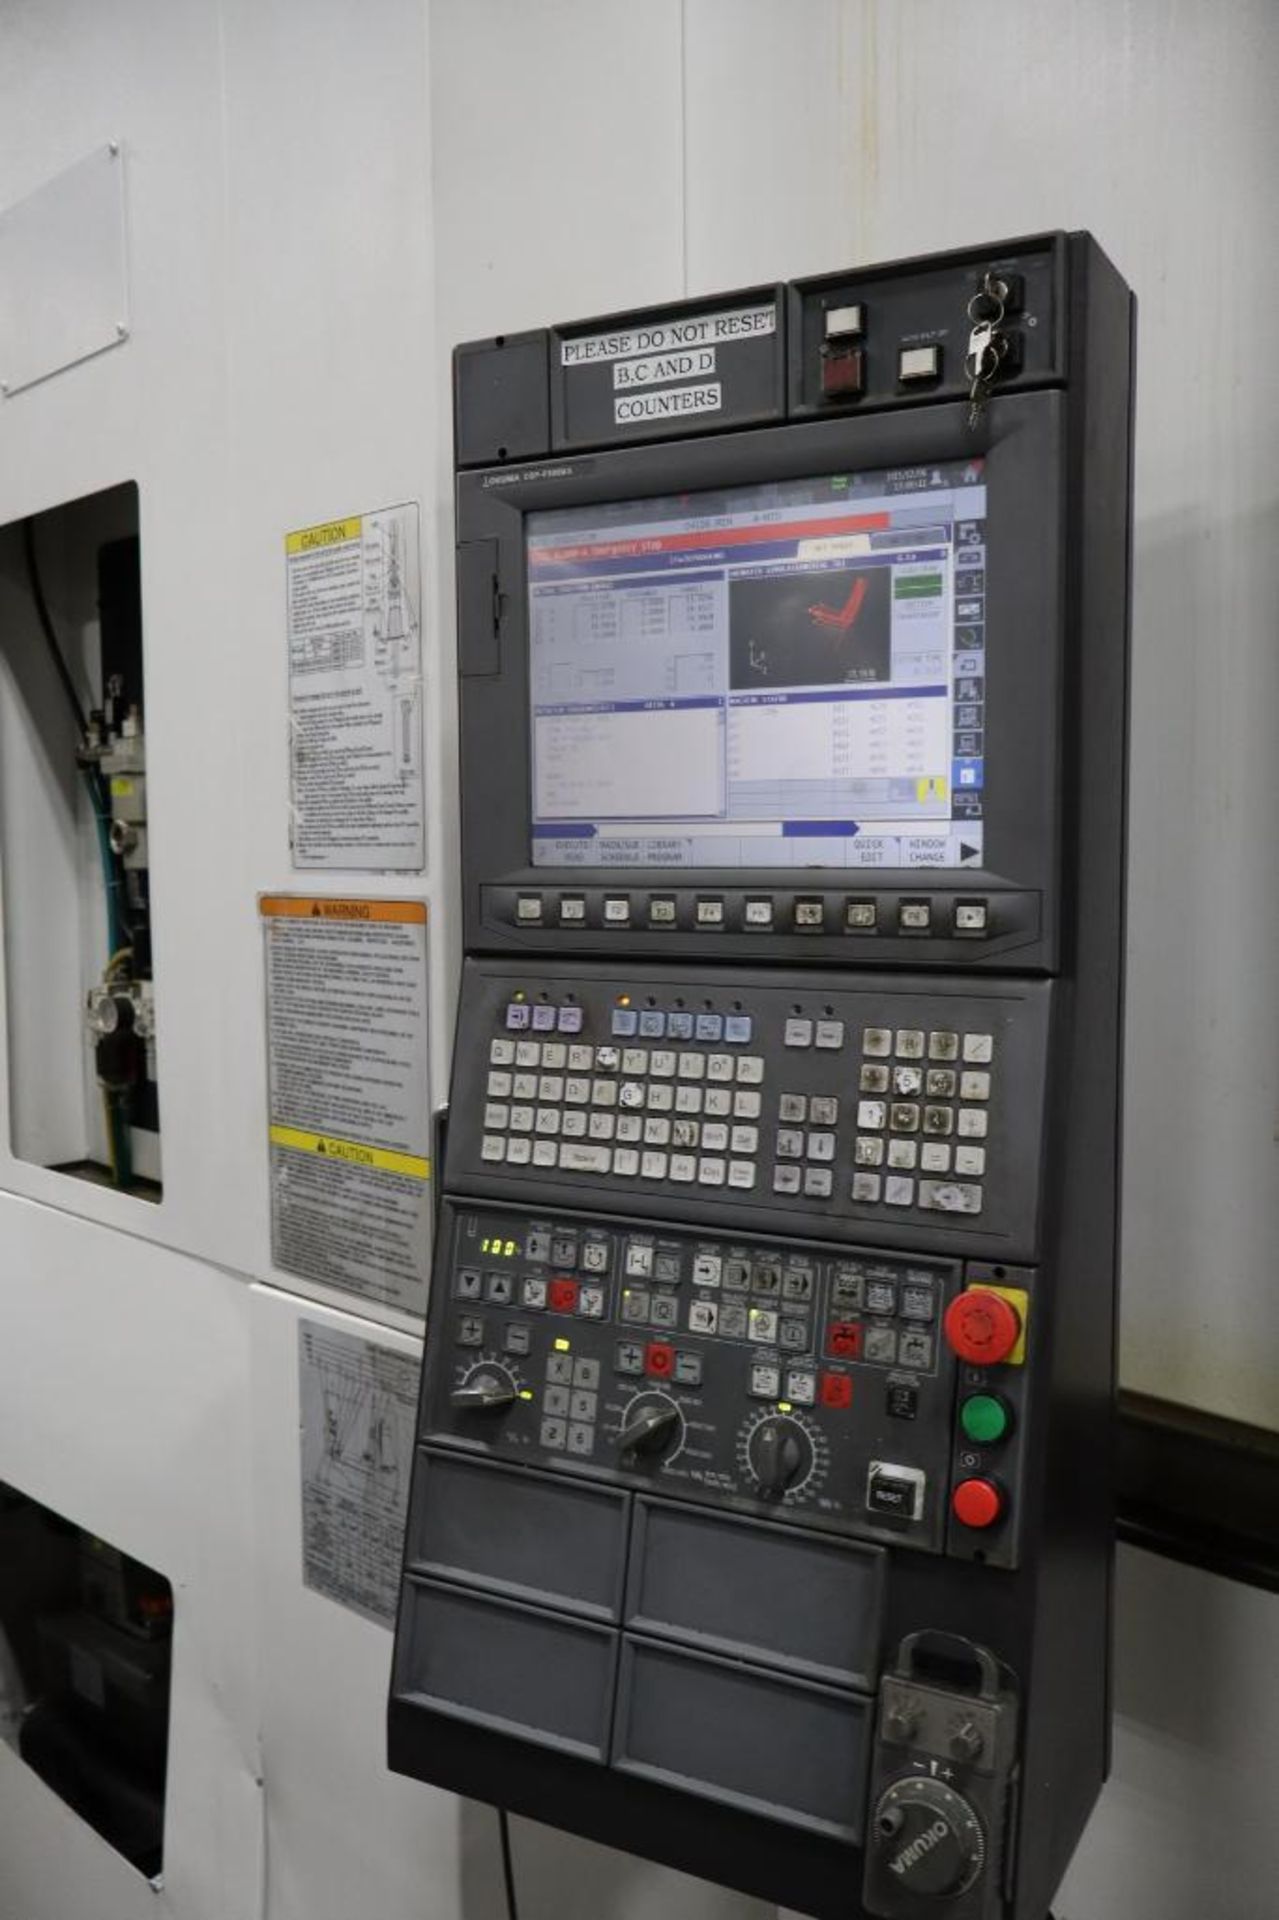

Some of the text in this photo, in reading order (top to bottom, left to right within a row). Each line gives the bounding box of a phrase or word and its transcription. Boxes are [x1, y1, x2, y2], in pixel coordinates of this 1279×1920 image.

[563, 335, 631, 362] PLEASE
[637, 330, 665, 349] DO
[670, 322, 708, 345] NOT
[653, 356, 693, 377] AND
[699, 353, 713, 370] D
[616, 388, 719, 419] COUNTERS
[300, 525, 346, 550] CAUTION
[909, 851, 945, 863] CHANGE
[323, 902, 370, 919] WARNING
[328, 1141, 374, 1164] CAUTION
[480, 1239, 516, 1257] 100
[888, 1821, 949, 1874] OKUMA
